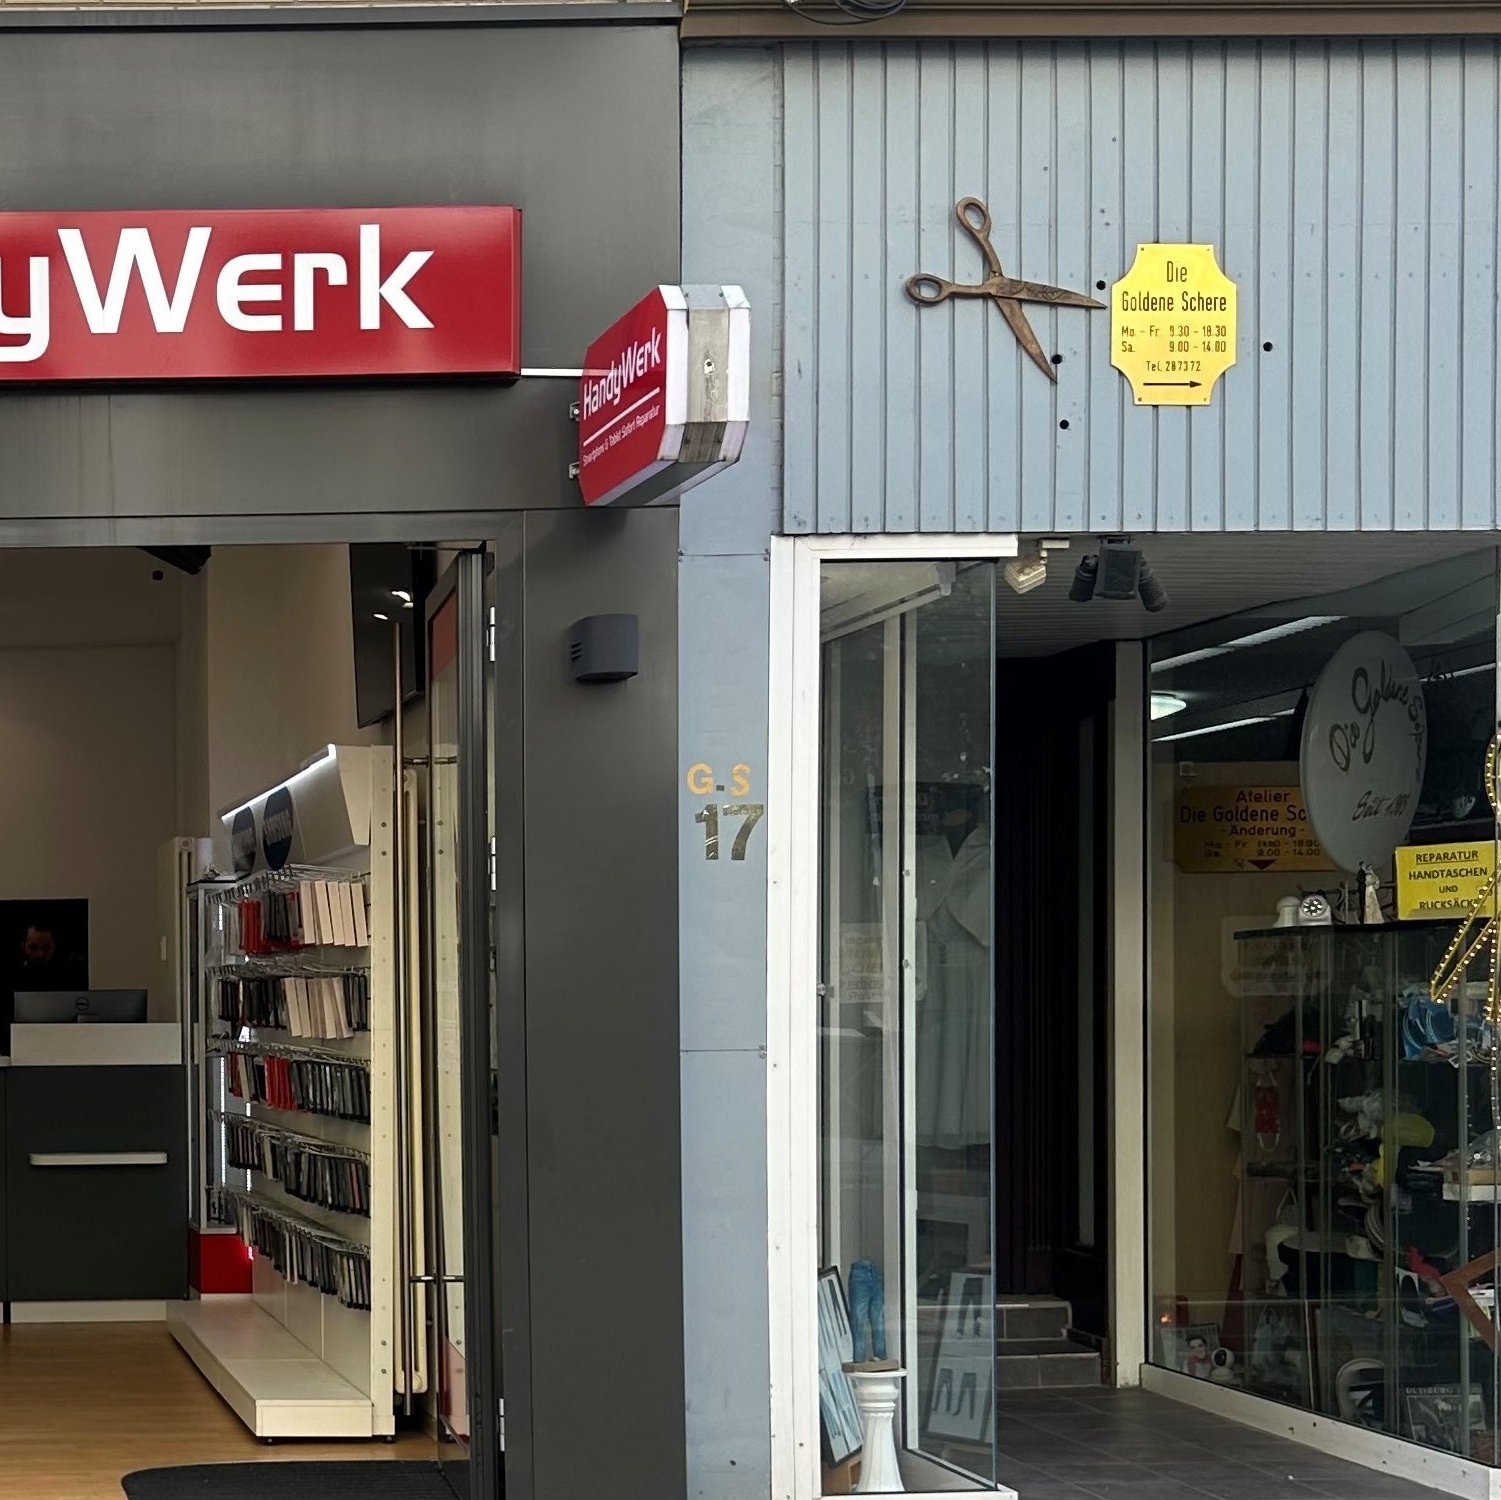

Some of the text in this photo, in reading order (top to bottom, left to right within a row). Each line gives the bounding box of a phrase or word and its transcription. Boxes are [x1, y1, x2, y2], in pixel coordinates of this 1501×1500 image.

[1166, 260, 1188, 283] Die
[1121, 290, 1227, 312] Goldene Schere
[1202, 324, 1227, 338] 18.30
[1168, 340, 1190, 353] 9.00
[1202, 340, 1227, 353] 14.00
[583, 326, 662, 421] HandyWerk
[1235, 790, 1290, 803] Atelier
[1180, 805, 1206, 823] Die
[1213, 805, 1279, 822] Goldene
[694, 804, 763, 860] 17
[1415, 850, 1479, 863] REPARATUR
[1408, 867, 1488, 880] HANDTASCHEN
[1438, 885, 1459, 894] UND
